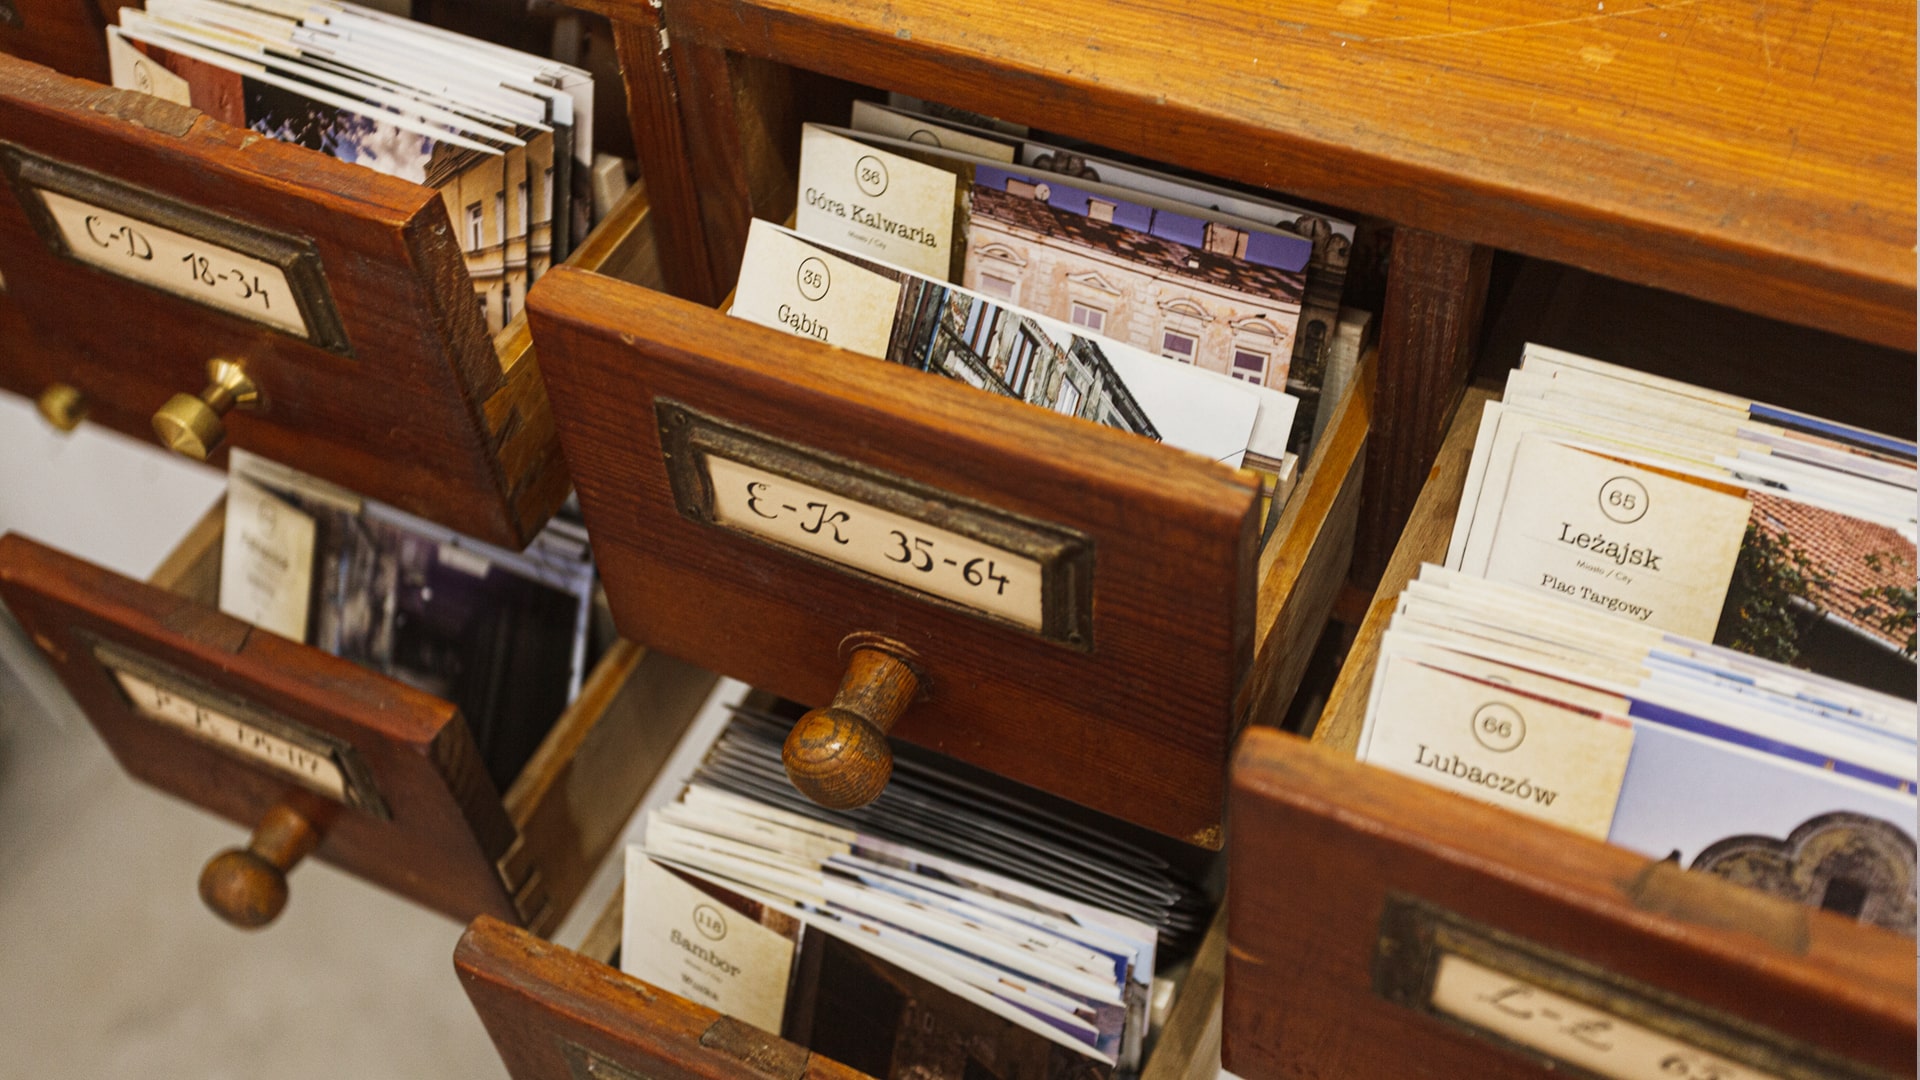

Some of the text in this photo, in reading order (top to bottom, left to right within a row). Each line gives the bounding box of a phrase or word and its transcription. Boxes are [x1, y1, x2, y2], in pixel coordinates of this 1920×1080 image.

[861, 167, 880, 185] 36
[805, 187, 938, 248] Góra Kalwaria
[182, 252, 270, 309] 18-34
[803, 269, 823, 289] 35
[778, 303, 829, 342] Gąbin
[1609, 489, 1637, 511] 65
[884, 530, 1010, 595] 35-64
[1558, 521, 1663, 571] Leżajsk
[1540, 572, 1653, 621] Plac Targowy
[1615, 571, 1633, 585] City
[1482, 716, 1512, 738] 66
[1415, 744, 1559, 807] Lubaczów
[670, 927, 741, 977] Sambor
